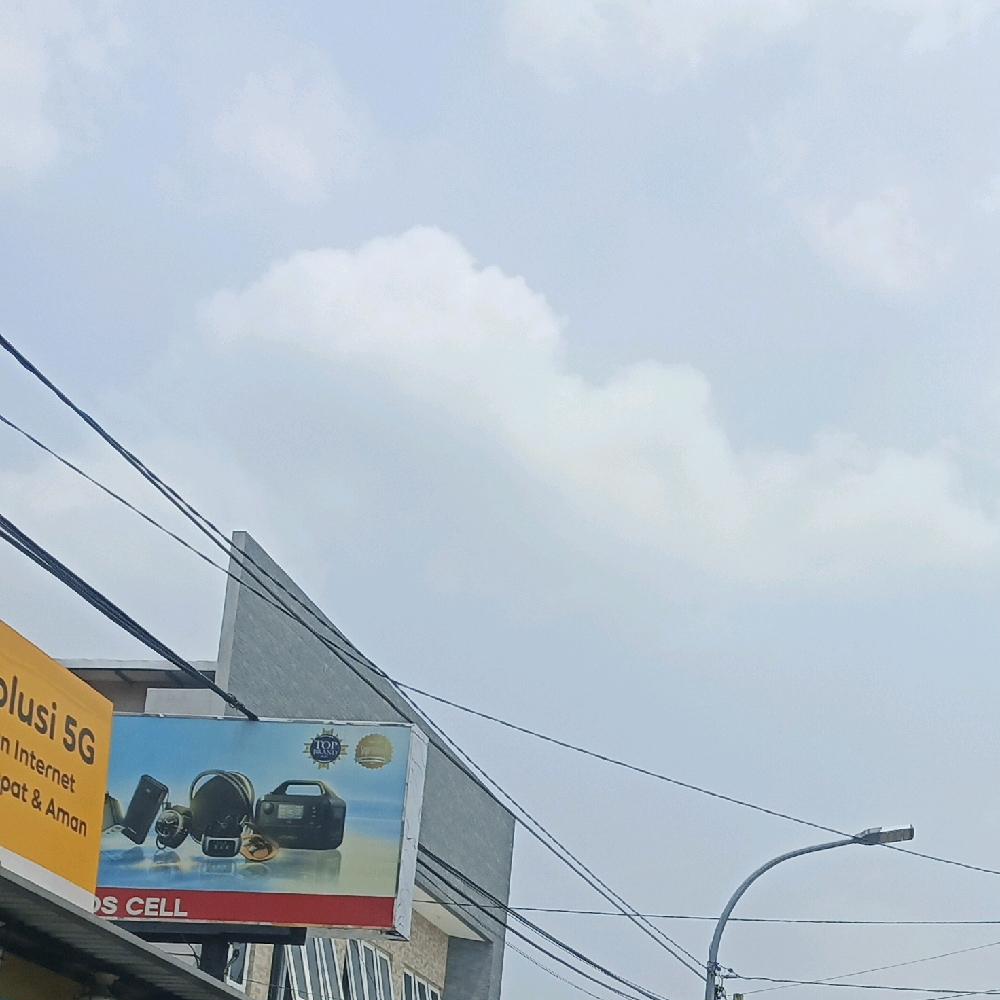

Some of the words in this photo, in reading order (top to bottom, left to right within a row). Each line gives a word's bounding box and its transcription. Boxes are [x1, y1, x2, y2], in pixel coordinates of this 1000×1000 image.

[63, 714, 95, 765] 5G
[313, 748, 338, 756] BRAND
[314, 740, 338, 750] TOP
[14, 740, 75, 793] Internet
[31, 789, 42, 812] &
[46, 798, 87, 838] Aman
[126, 896, 188, 917] CELL
